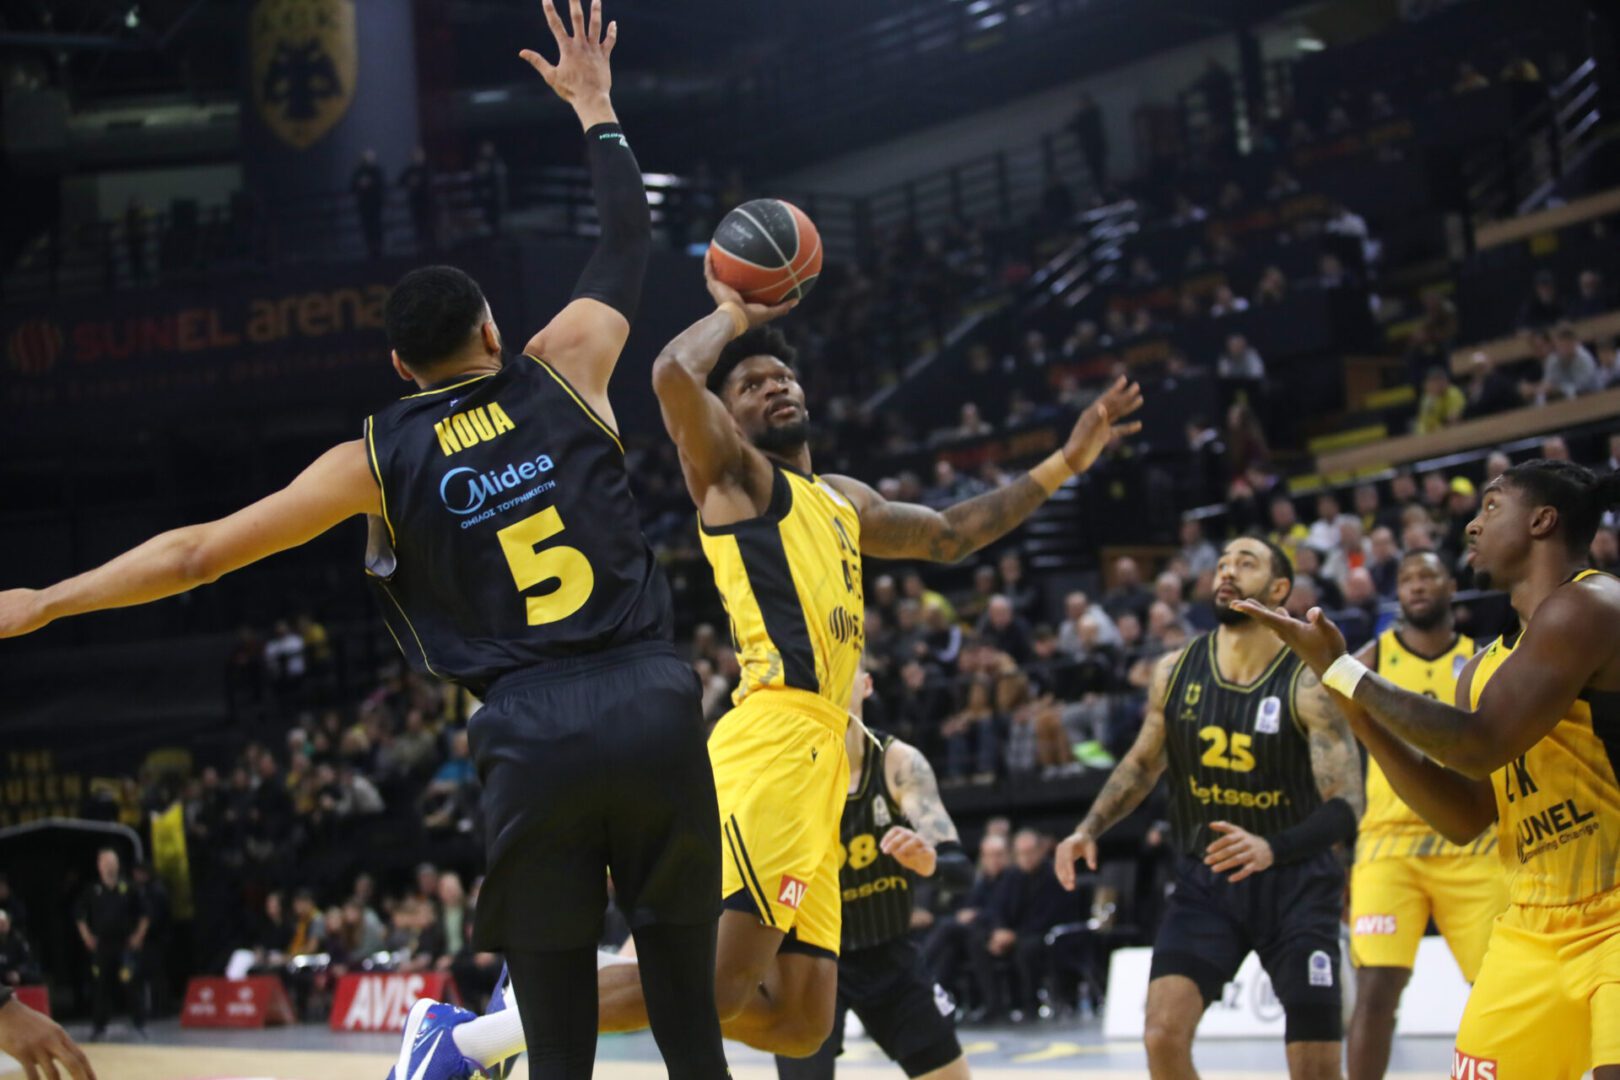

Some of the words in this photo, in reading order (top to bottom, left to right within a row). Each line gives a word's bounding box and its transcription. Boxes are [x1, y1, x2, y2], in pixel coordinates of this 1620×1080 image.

[73, 309, 240, 364] SUNEL
[246, 284, 390, 342] arena
[434, 402, 516, 457] NOUA
[440, 454, 555, 515] Midea
[460, 508, 496, 529] ΟΜΙΛΟΣ
[496, 505, 595, 626] 5
[1199, 725, 1256, 772] 25
[1355, 914, 1396, 935] AVIS
[343, 974, 426, 1030] AVIS
